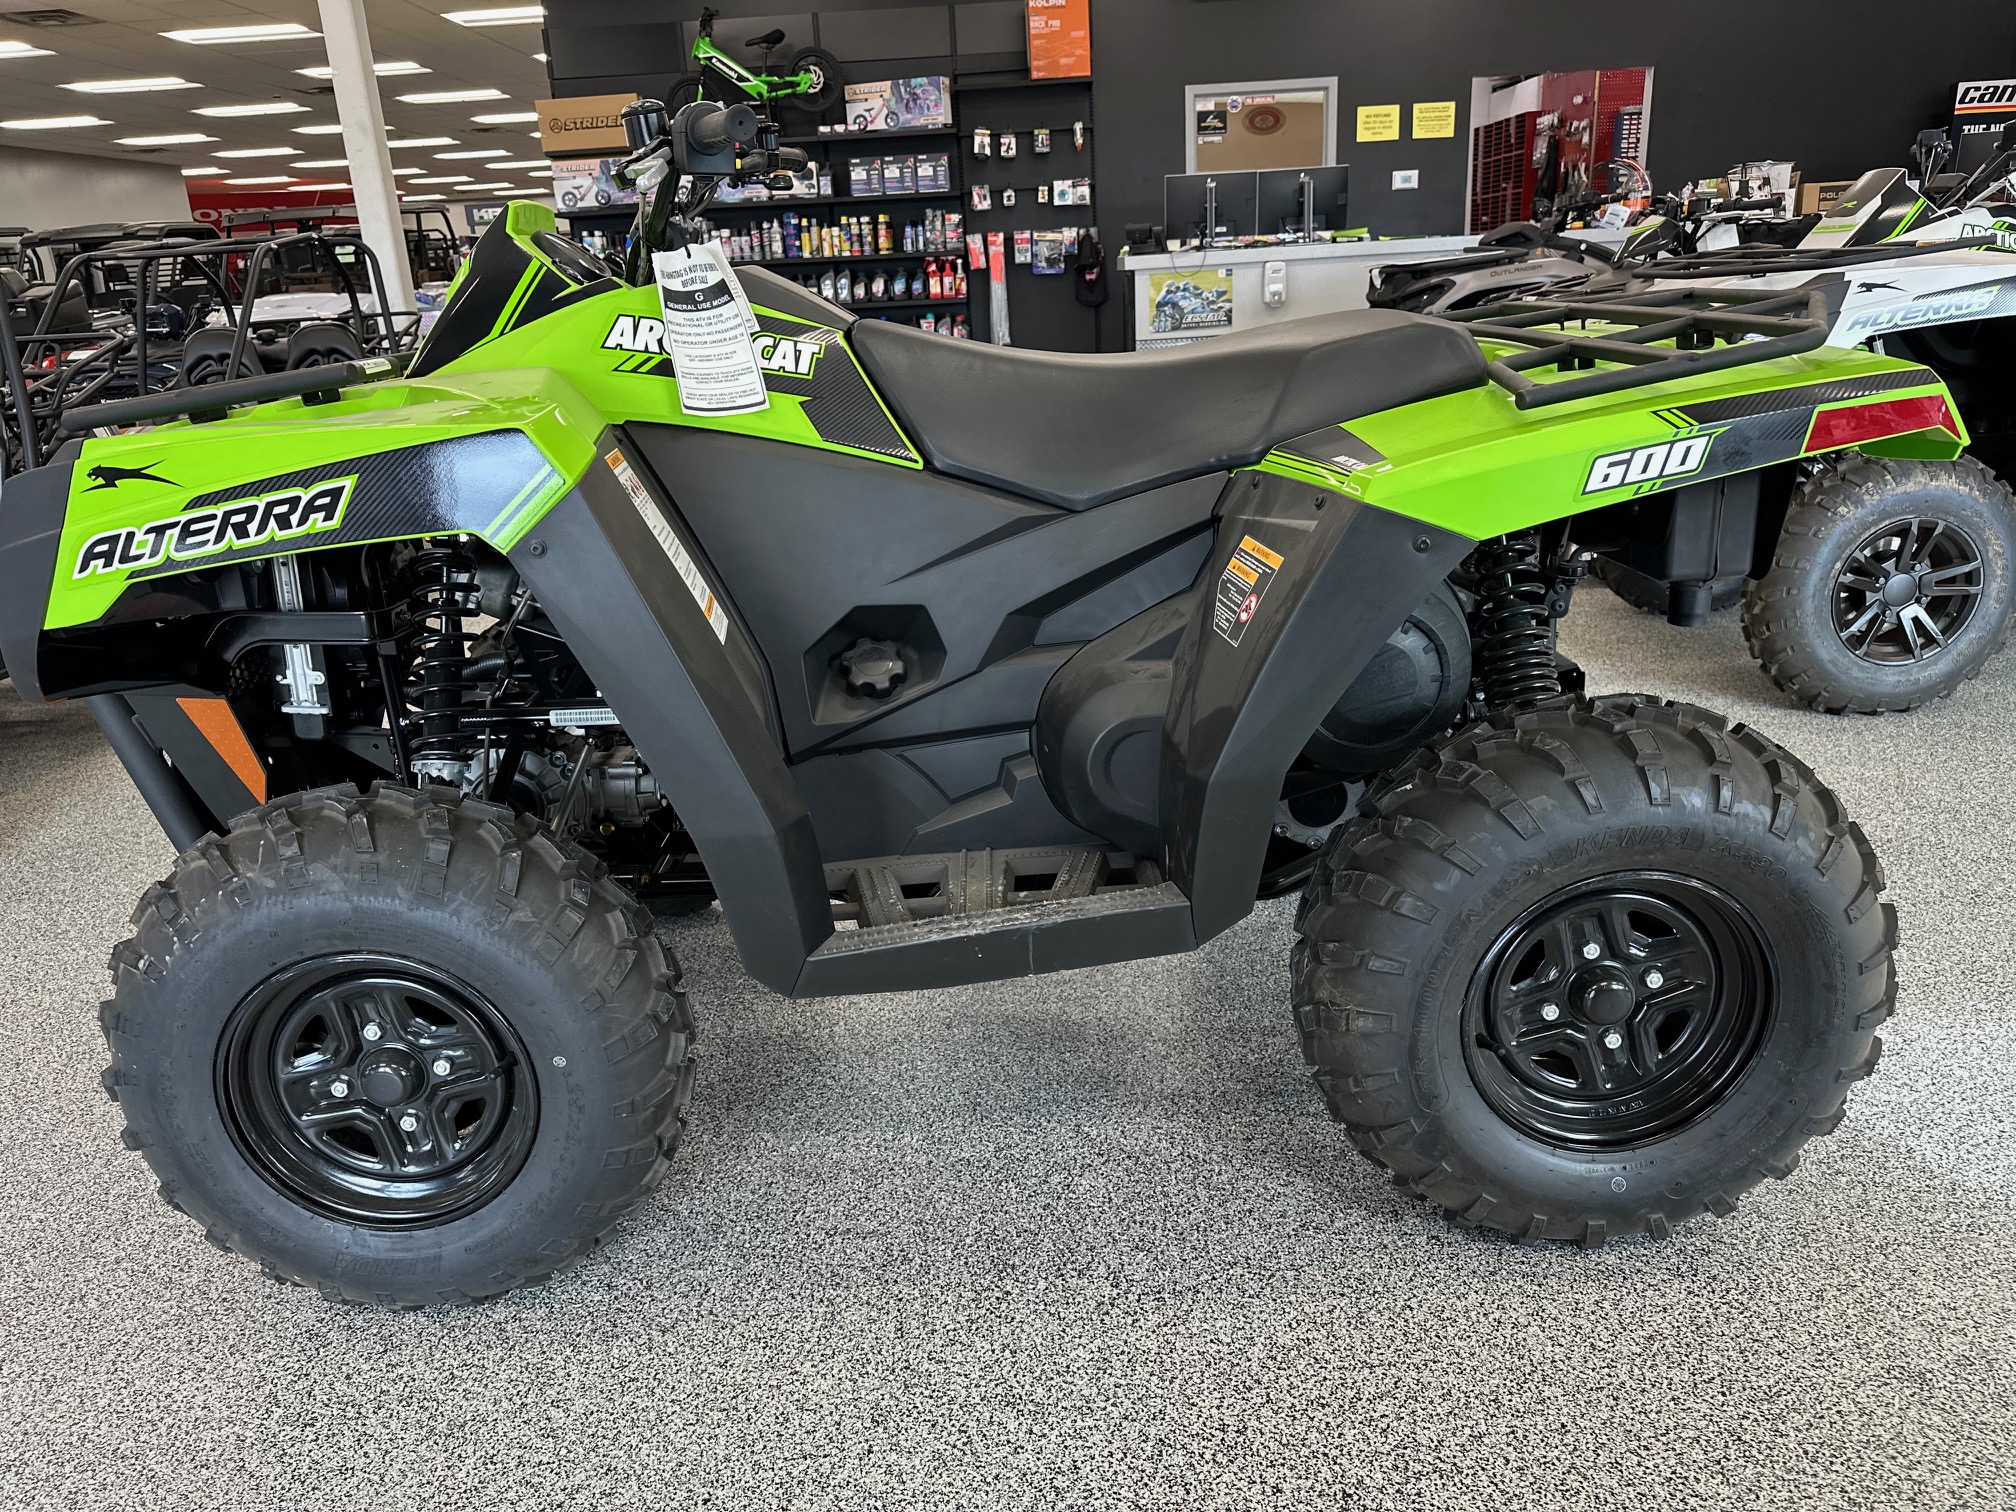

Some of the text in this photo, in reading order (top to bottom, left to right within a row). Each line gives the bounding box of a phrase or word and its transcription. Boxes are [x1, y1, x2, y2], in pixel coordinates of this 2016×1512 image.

[854, 86, 887, 95] STRIDER
[562, 164, 596, 172] STRIDER
[1490, 264, 1543, 278] OUTLANDER
[681, 275, 708, 288] BEFORE SALE
[666, 302, 697, 310] GENERAL
[712, 294, 731, 306] MODEL
[694, 292, 704, 301] G
[1844, 288, 1996, 333] ALTERRA
[713, 316, 732, 325] UTILITY
[670, 329, 692, 337] OPERATOR
[715, 322, 743, 335] PASSENGERS
[752, 334, 821, 376] CAT
[1585, 434, 1711, 493] 600
[74, 482, 354, 580] ALTERRA
[1574, 823, 1692, 858] KENDA
